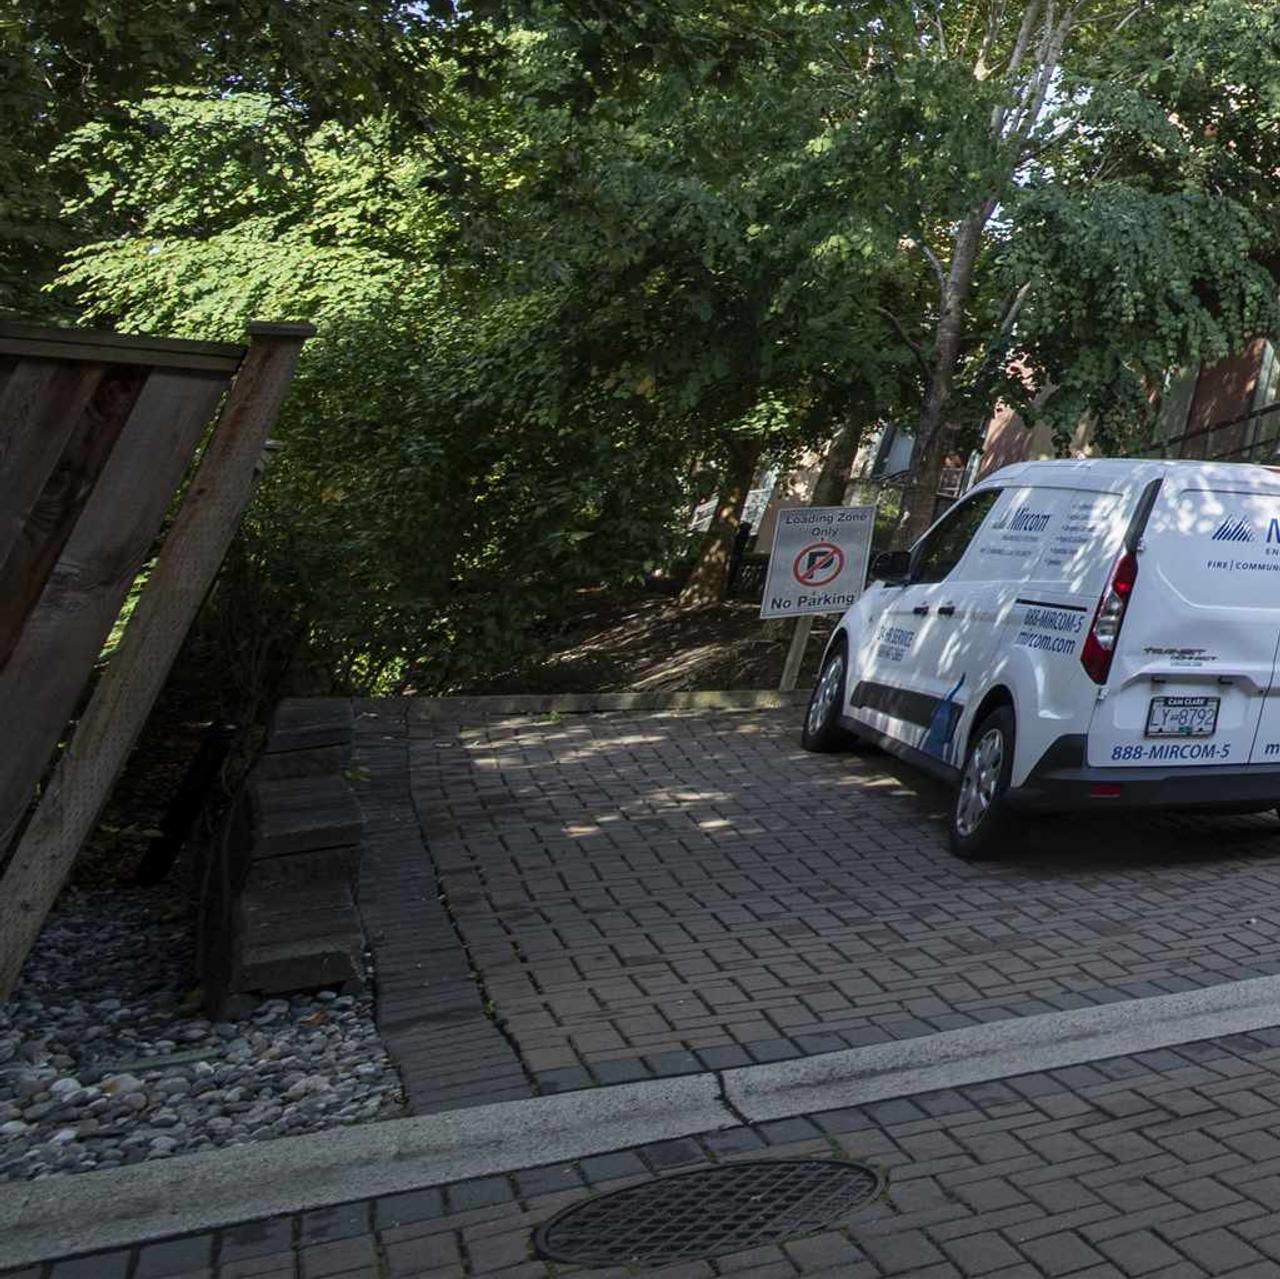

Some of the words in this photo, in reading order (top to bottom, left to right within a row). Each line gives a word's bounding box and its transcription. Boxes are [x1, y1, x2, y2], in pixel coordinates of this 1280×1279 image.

[785, 512, 834, 525] Loading
[837, 512, 867, 523] Zone
[1008, 506, 1052, 532] Mircom
[811, 527, 839, 537] Only
[771, 597, 792, 610] No
[798, 592, 855, 607] Parking
[1014, 628, 1076, 655] mircom.com
[1111, 743, 1231, 760] 888-MIRCOM-5
